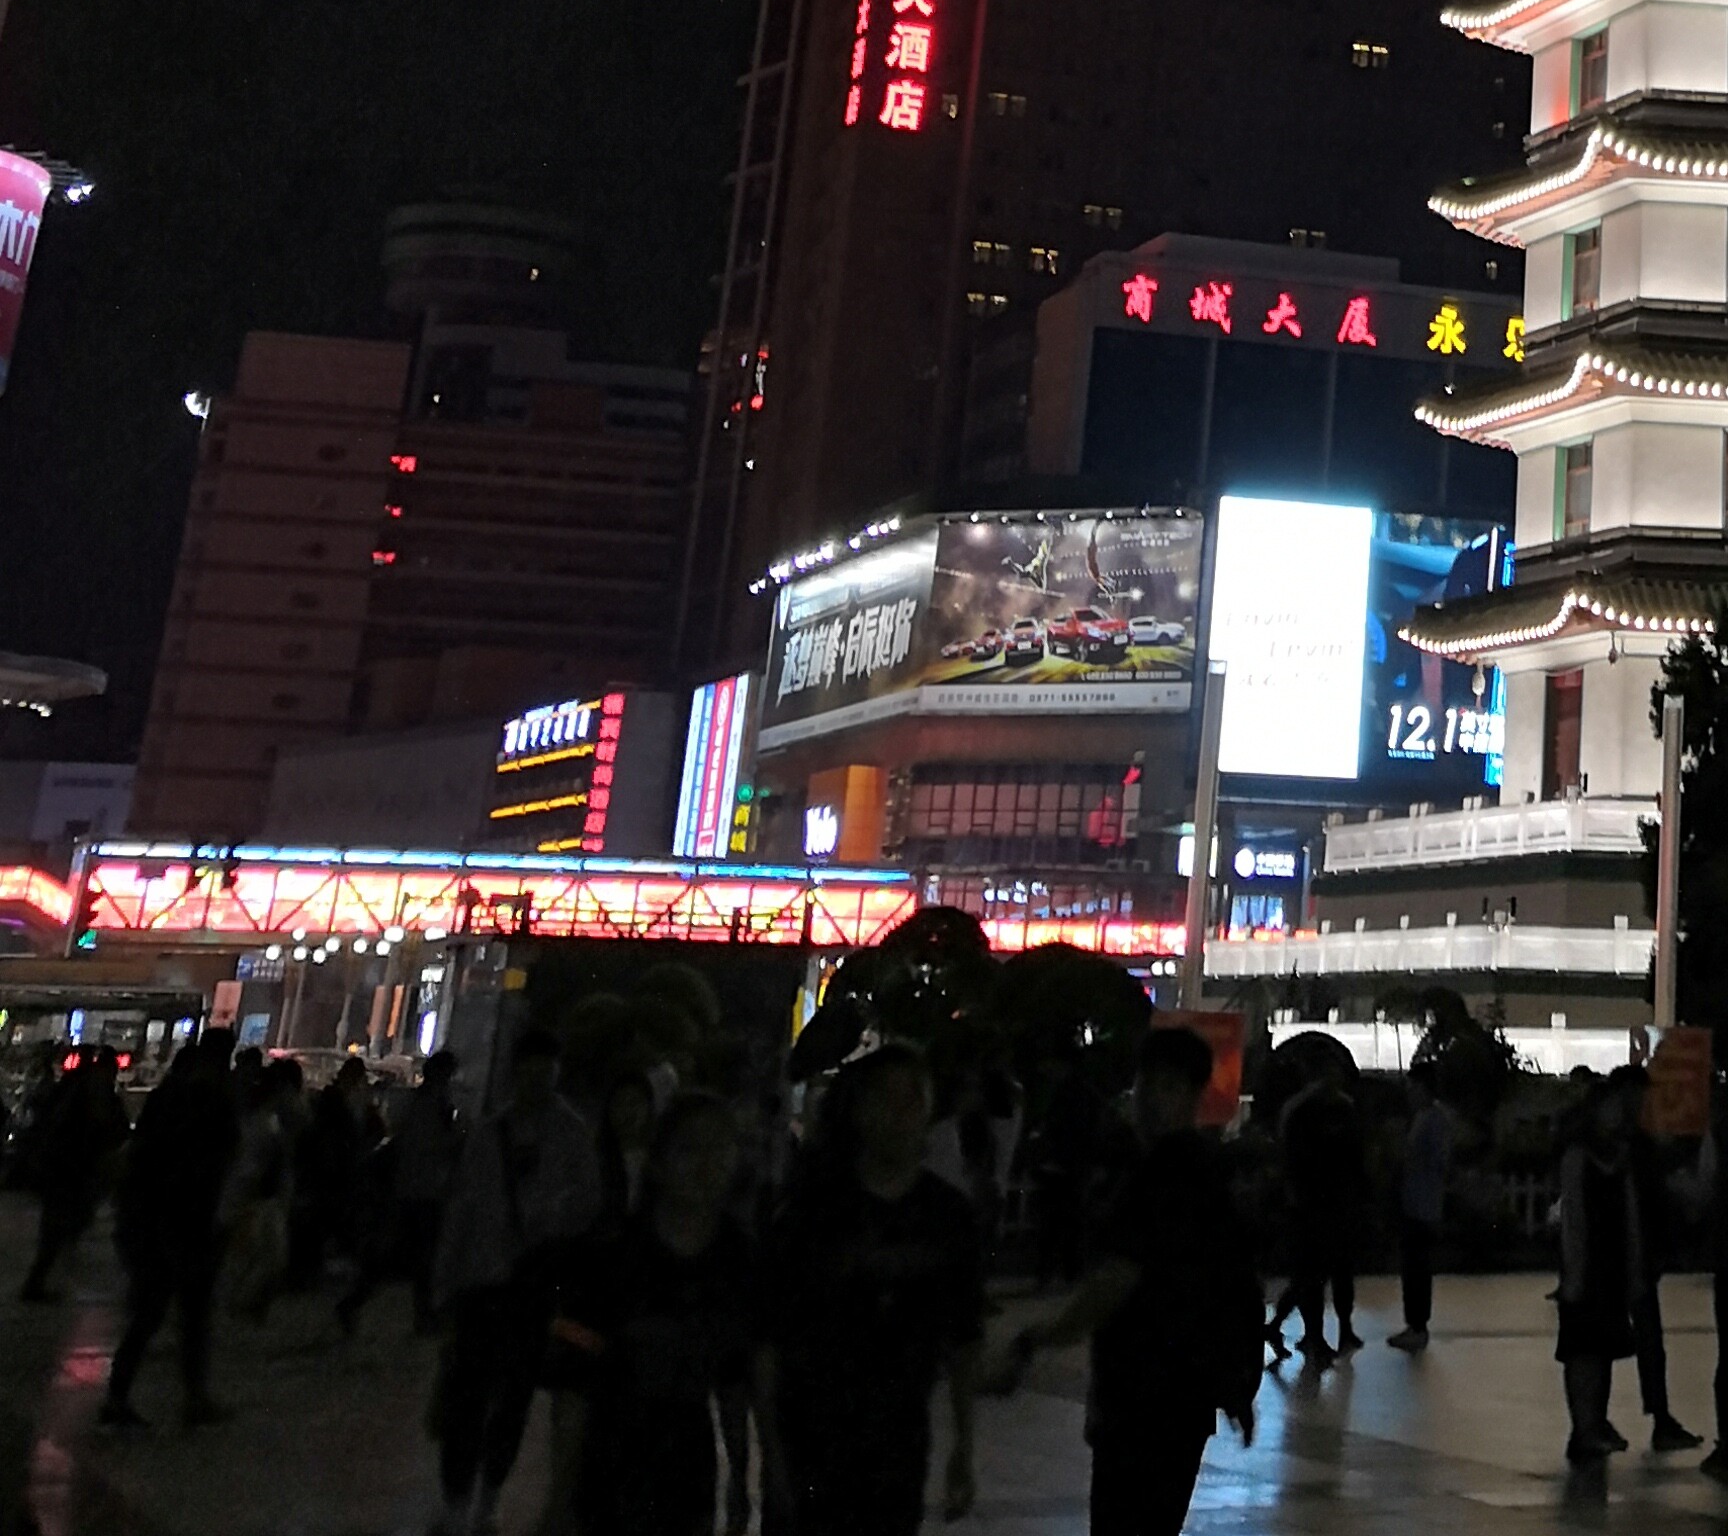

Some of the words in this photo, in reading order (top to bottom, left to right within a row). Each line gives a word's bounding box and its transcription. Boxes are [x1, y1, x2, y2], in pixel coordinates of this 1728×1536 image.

[1122, 274, 1377, 347] 商城大厦
[1388, 705, 1458, 753] 12.1
